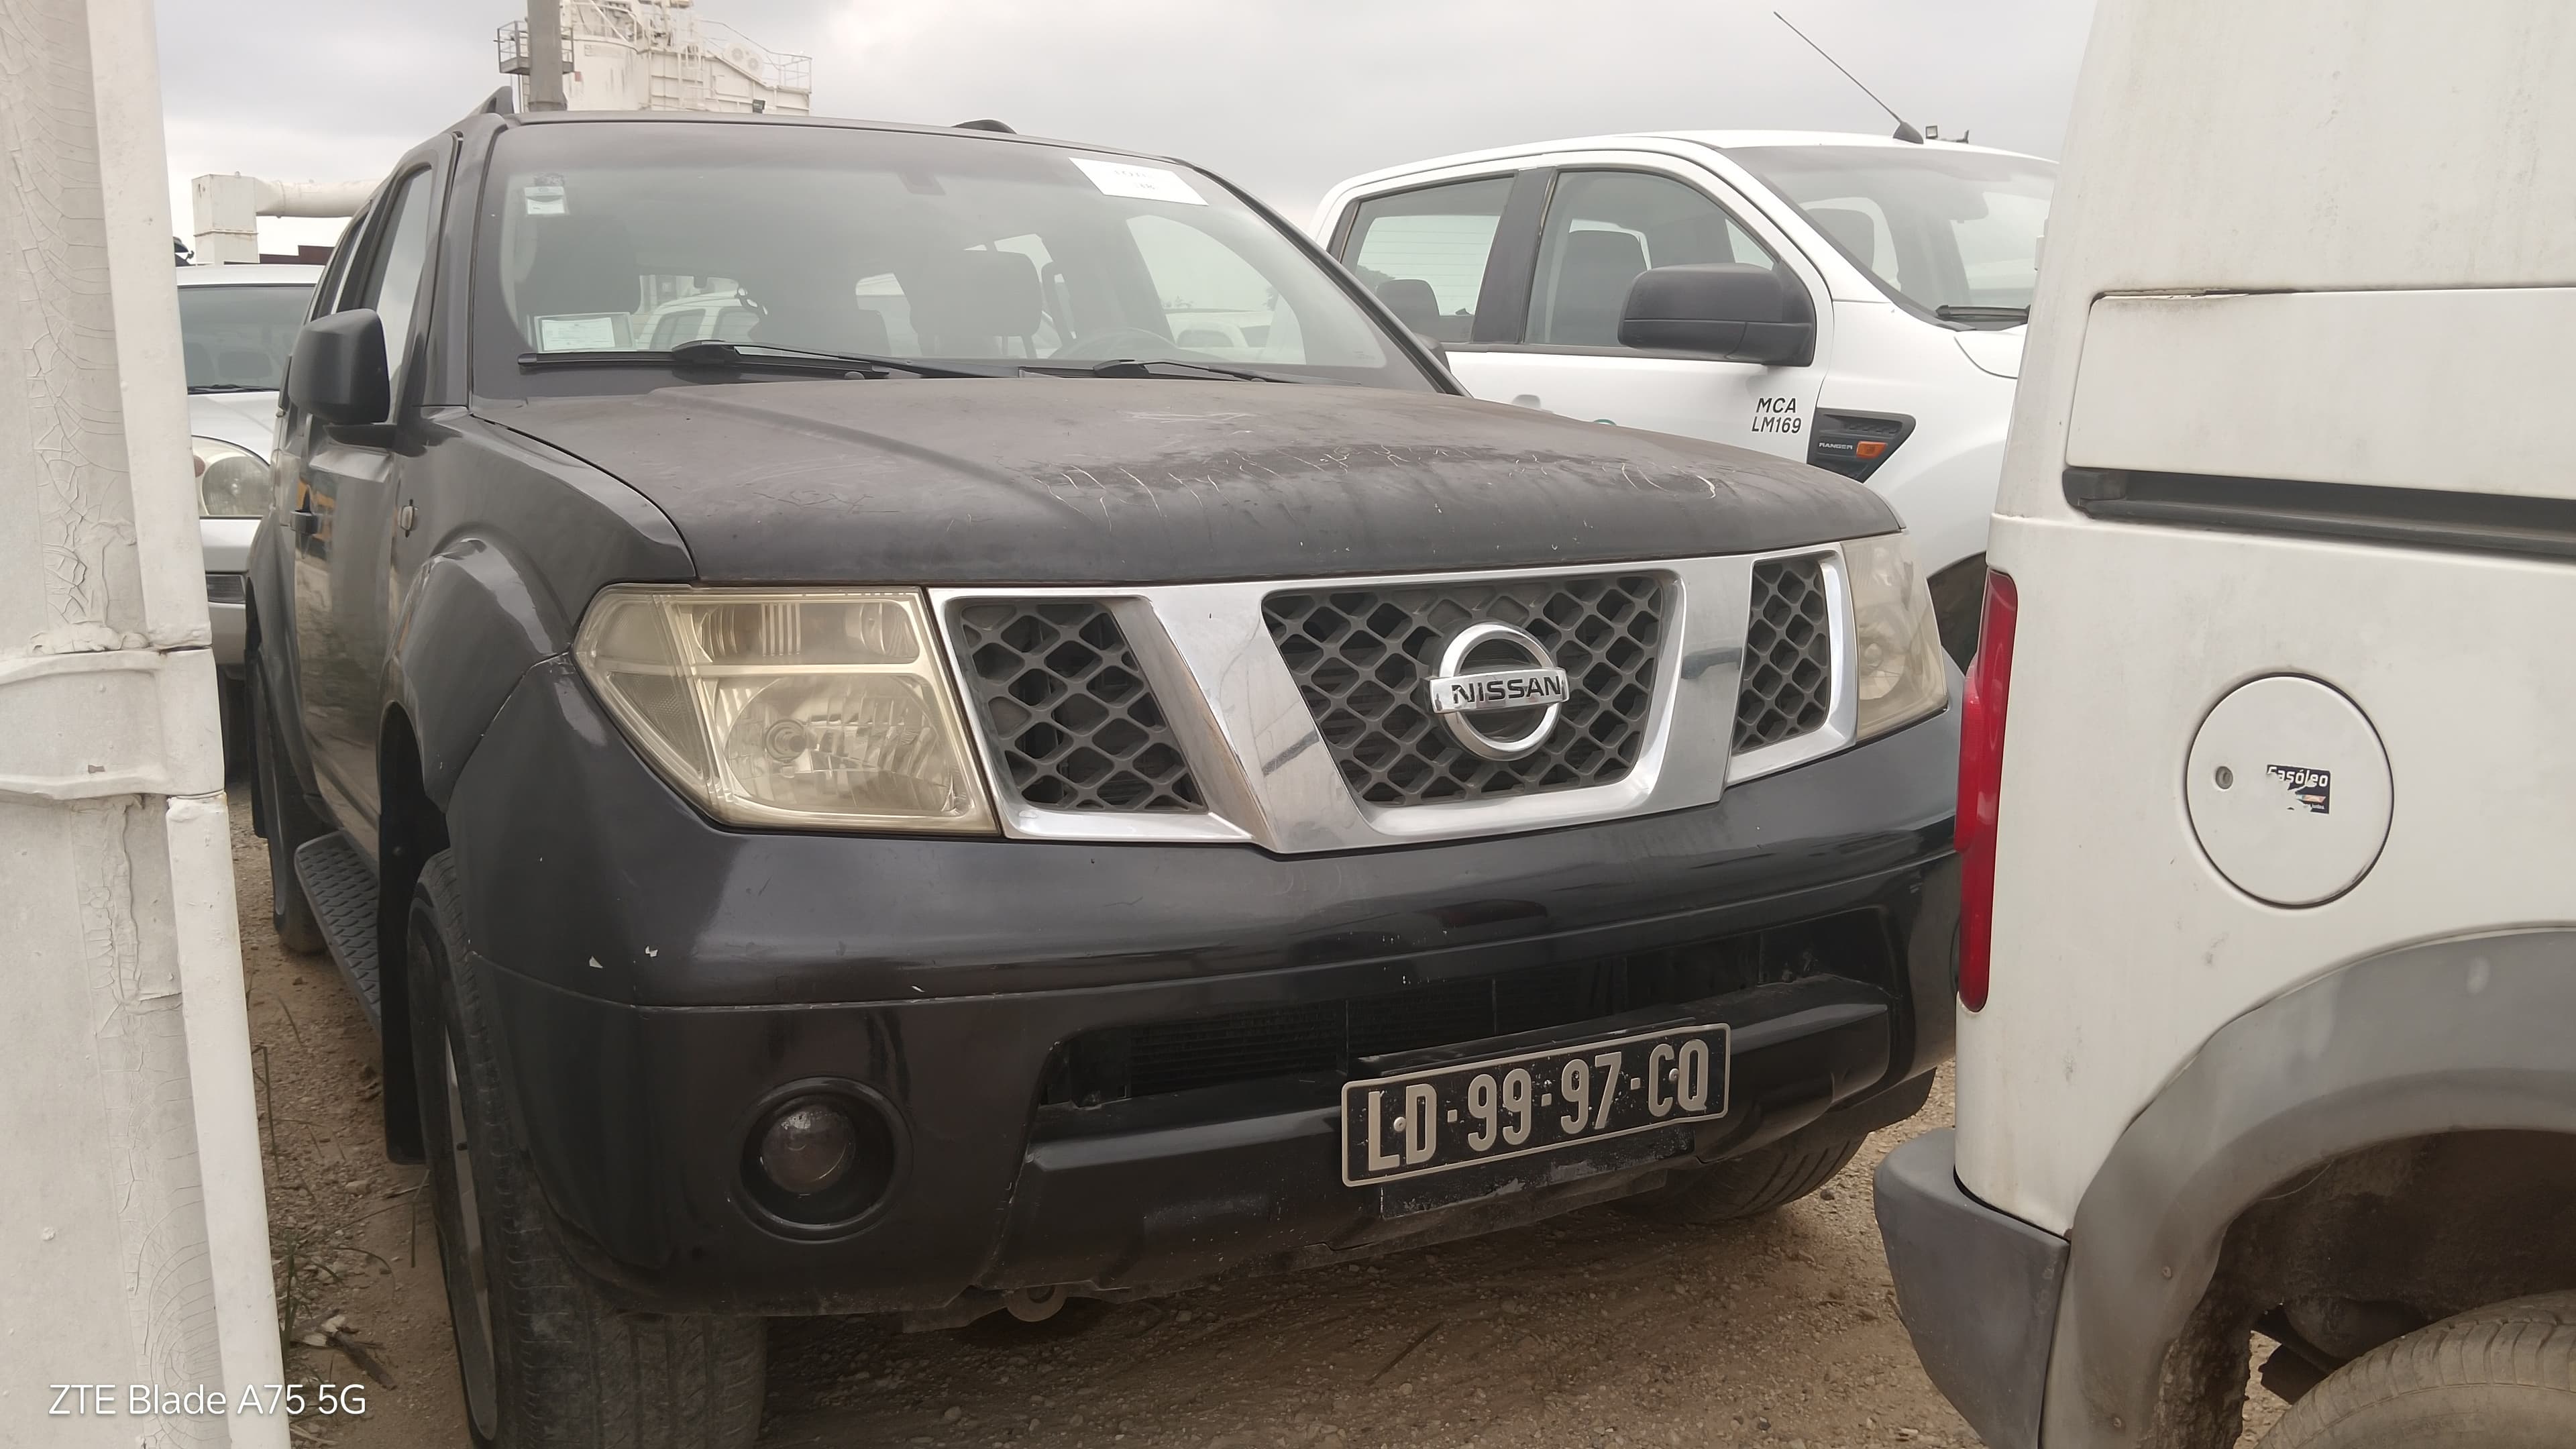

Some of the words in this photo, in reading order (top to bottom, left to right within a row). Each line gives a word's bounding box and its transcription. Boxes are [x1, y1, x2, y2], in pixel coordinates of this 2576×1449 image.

[1756, 397, 1796, 413] MCA
[1752, 416, 1802, 434] LM169
[1819, 442, 1853, 450] RANGER
[1451, 676, 1562, 704] NISSAN
